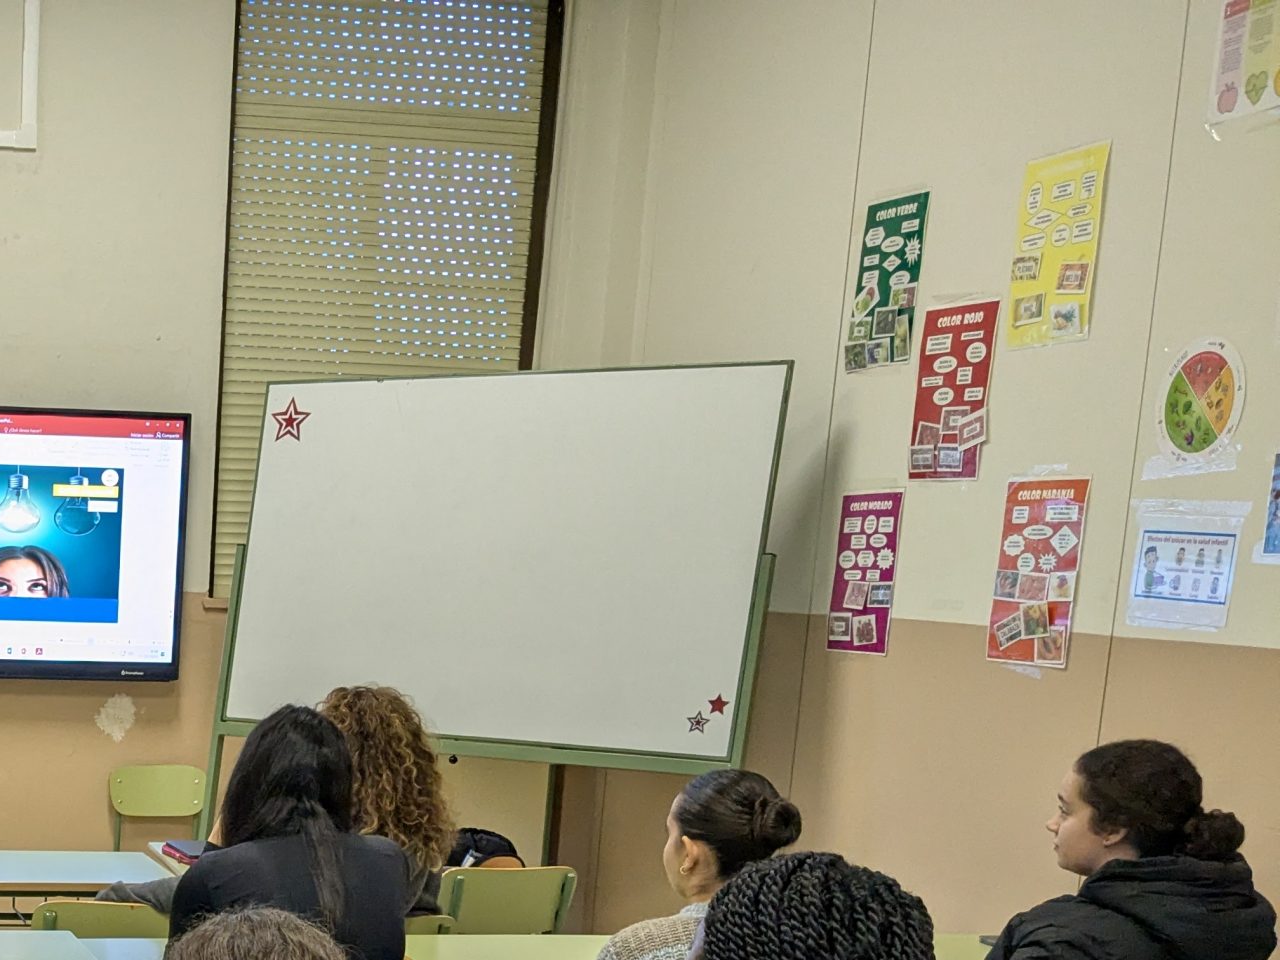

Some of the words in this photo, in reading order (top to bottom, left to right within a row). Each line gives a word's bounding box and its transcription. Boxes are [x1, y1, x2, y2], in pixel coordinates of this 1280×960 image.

[876, 206, 896, 221] COLOR
[897, 202, 918, 216] VERDE
[937, 314, 962, 328] COLOR
[964, 311, 984, 324] ROJO
[1018, 489, 1041, 500] COLOR
[1042, 488, 1075, 500] NARANJA
[850, 502, 868, 512] COLOR
[868, 500, 893, 510] MORADO
